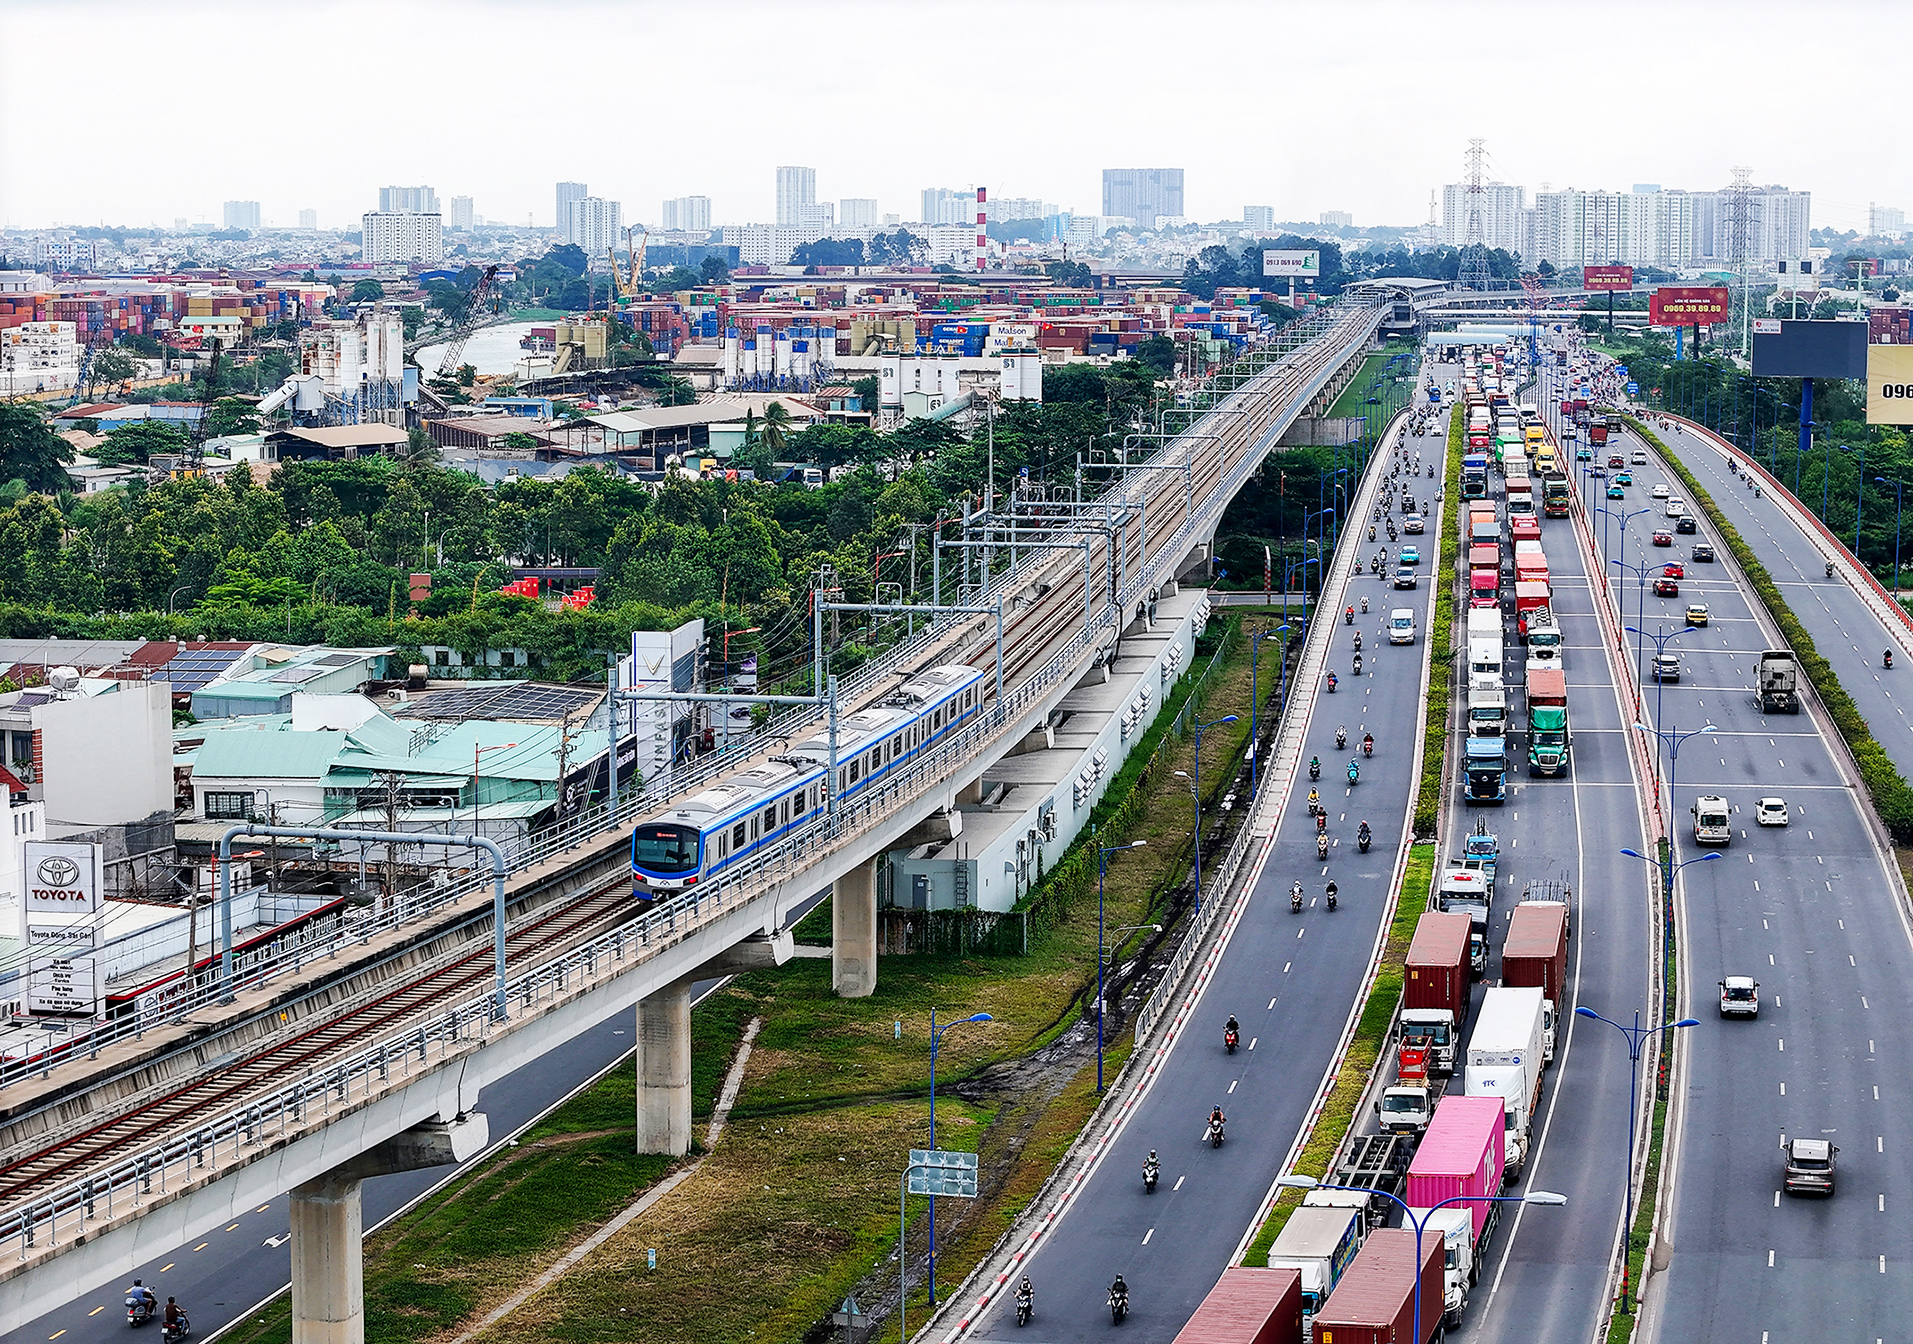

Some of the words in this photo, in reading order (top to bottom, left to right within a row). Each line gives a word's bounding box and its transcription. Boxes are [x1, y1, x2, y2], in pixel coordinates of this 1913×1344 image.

[997, 326, 1027, 336] Matson
[32, 890, 86, 901] TOYOTA
[31, 930, 50, 939] Toyota
